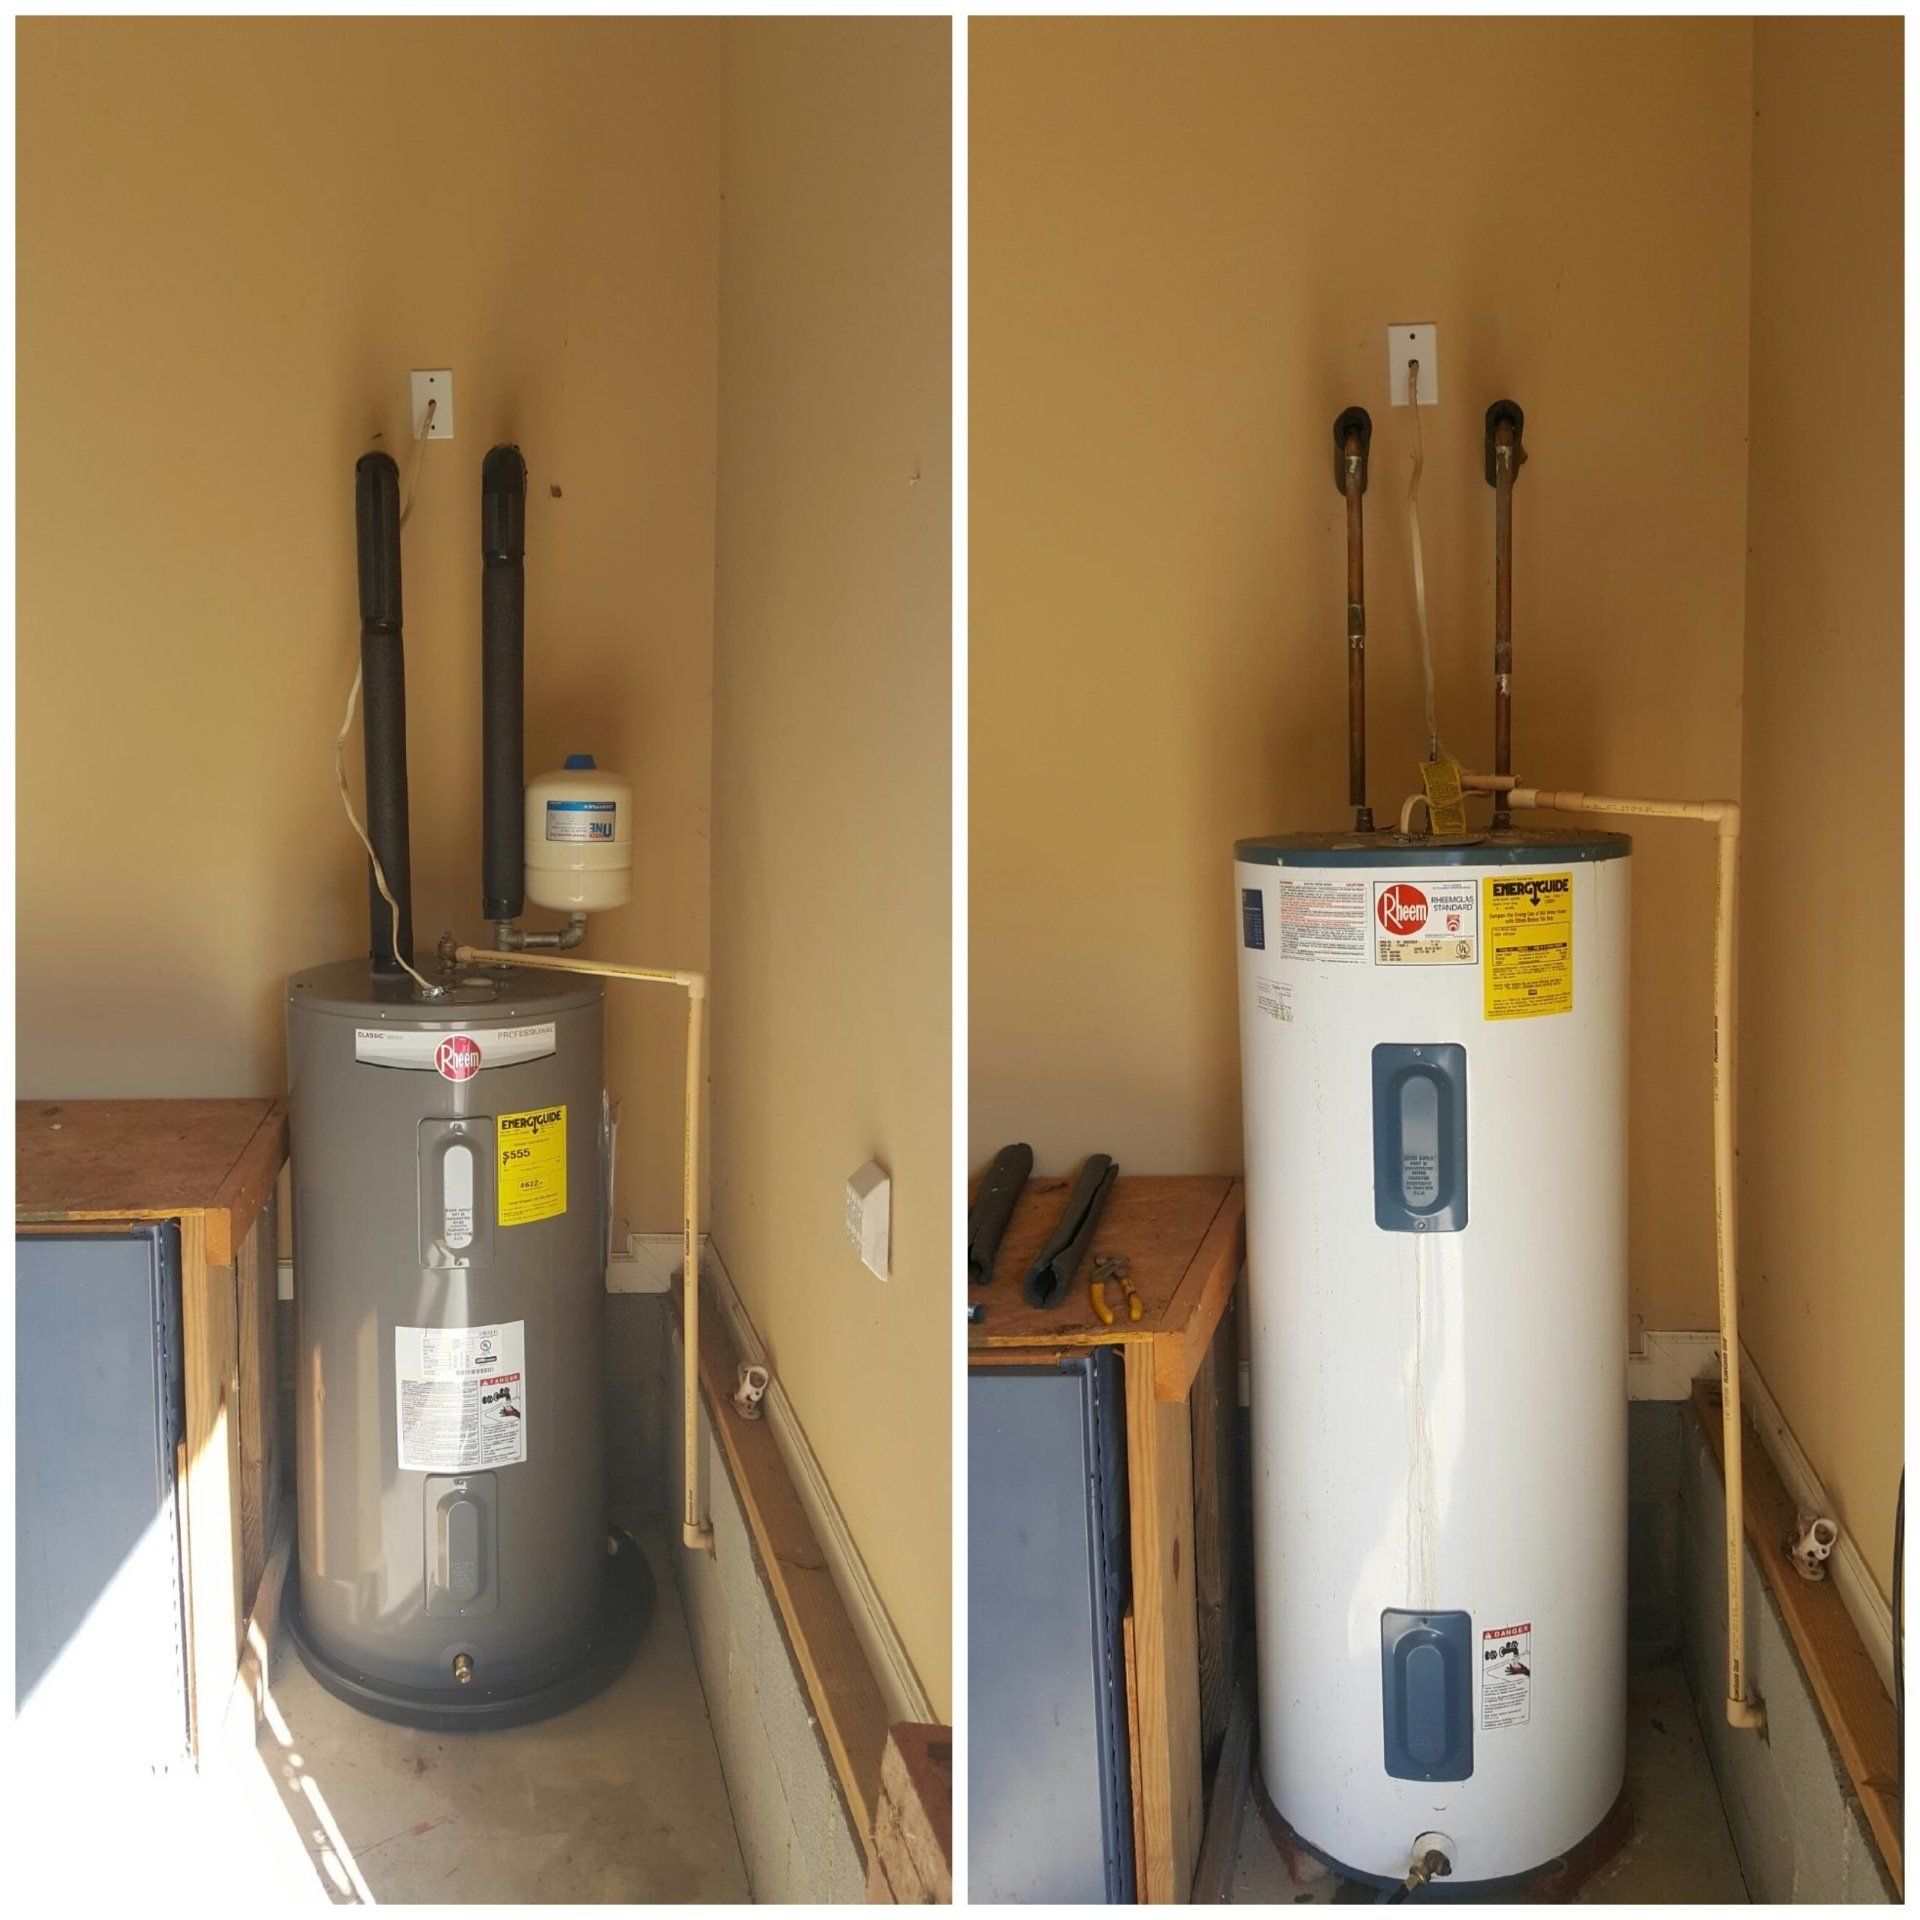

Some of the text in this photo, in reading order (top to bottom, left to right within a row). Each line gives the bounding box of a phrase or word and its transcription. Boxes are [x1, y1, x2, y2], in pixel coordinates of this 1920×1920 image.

[1493, 879, 1569, 897] ENERGYGUIDE
[1384, 886, 1427, 929] Rheem
[358, 1031, 384, 1039] CLASSIC
[498, 1028, 554, 1040] PROFESSIONAL
[441, 1036, 479, 1074] Rheem
[502, 1110, 562, 1130] ENERGYGUIDE
[502, 1148, 531, 1160] $555
[1494, 1625, 1529, 1637] DANGER
